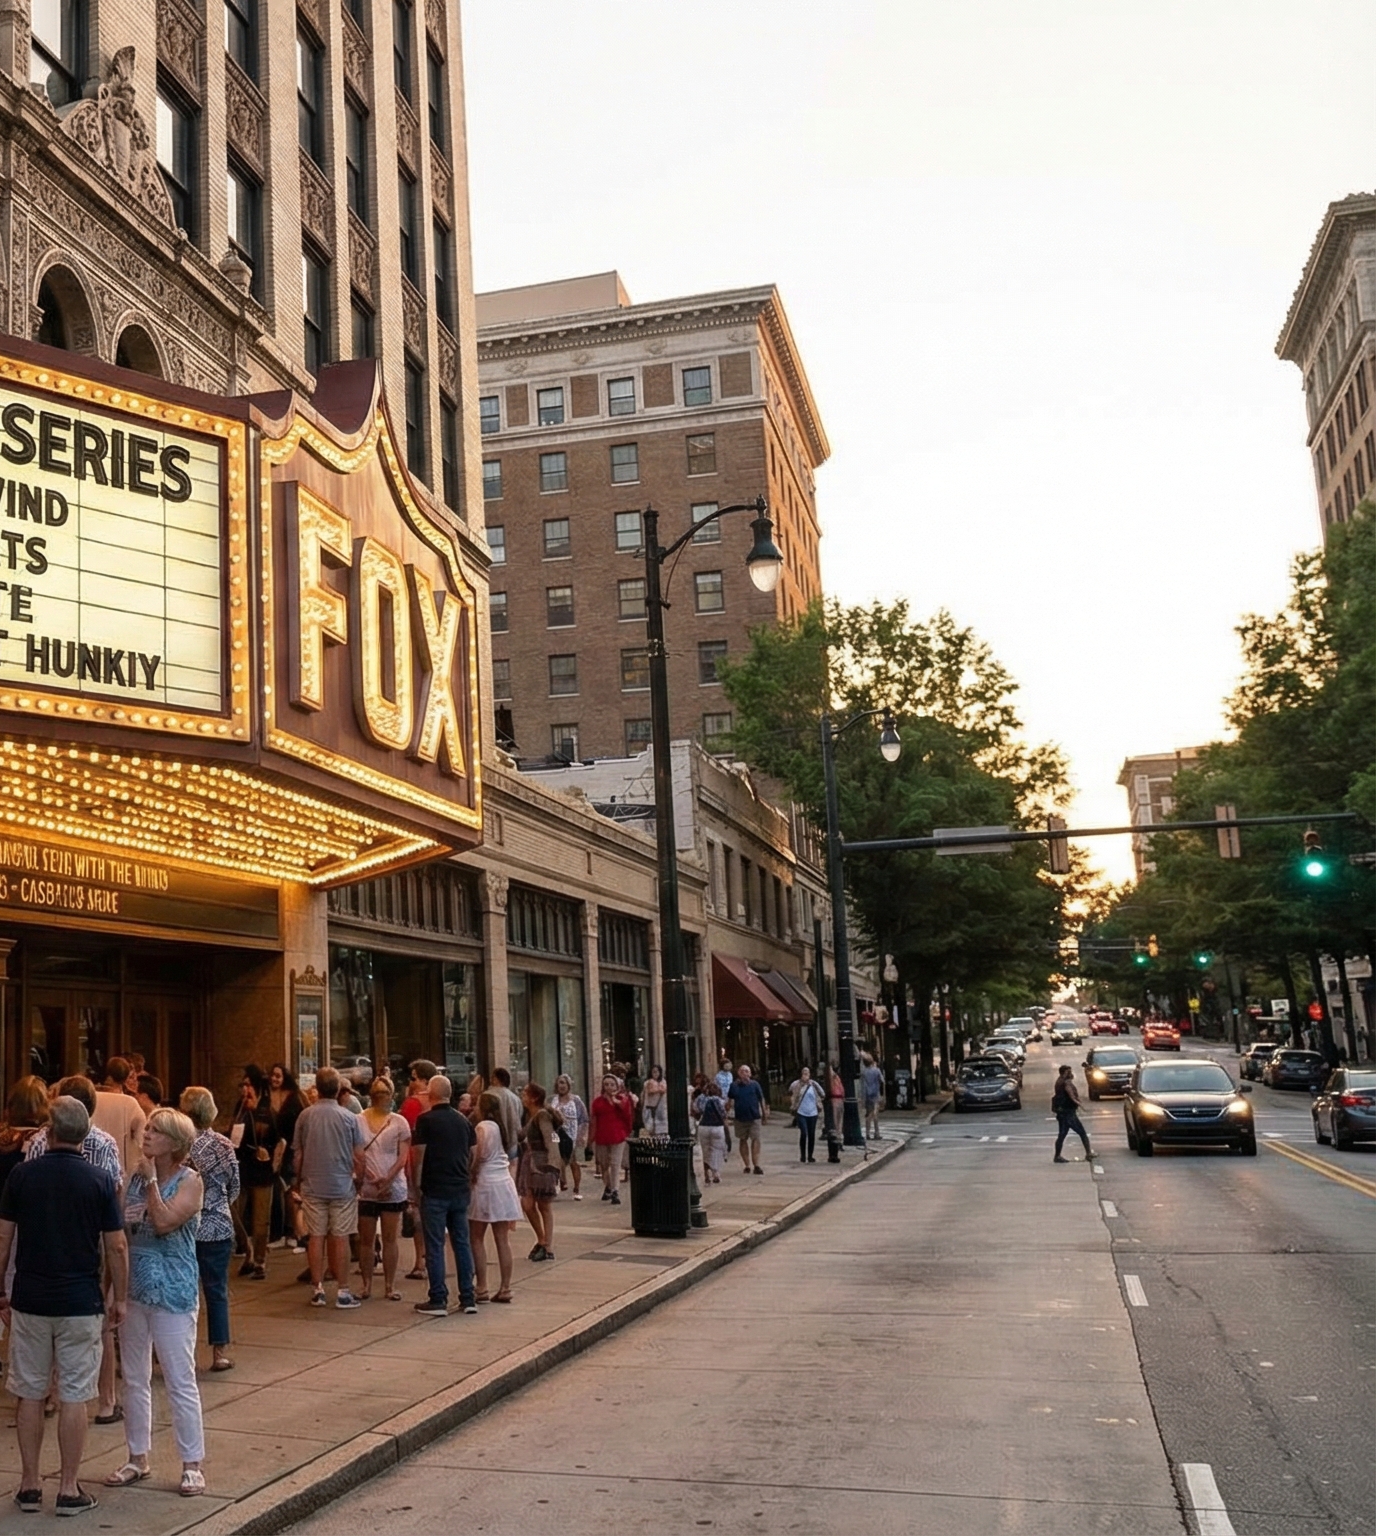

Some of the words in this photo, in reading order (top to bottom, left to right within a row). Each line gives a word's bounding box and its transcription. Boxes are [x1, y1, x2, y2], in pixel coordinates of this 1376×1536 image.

[0, 402, 193, 503] SERIES
[288, 480, 468, 779] FOX
[73, 853, 106, 881] WITH
[108, 859, 132, 885] THE
